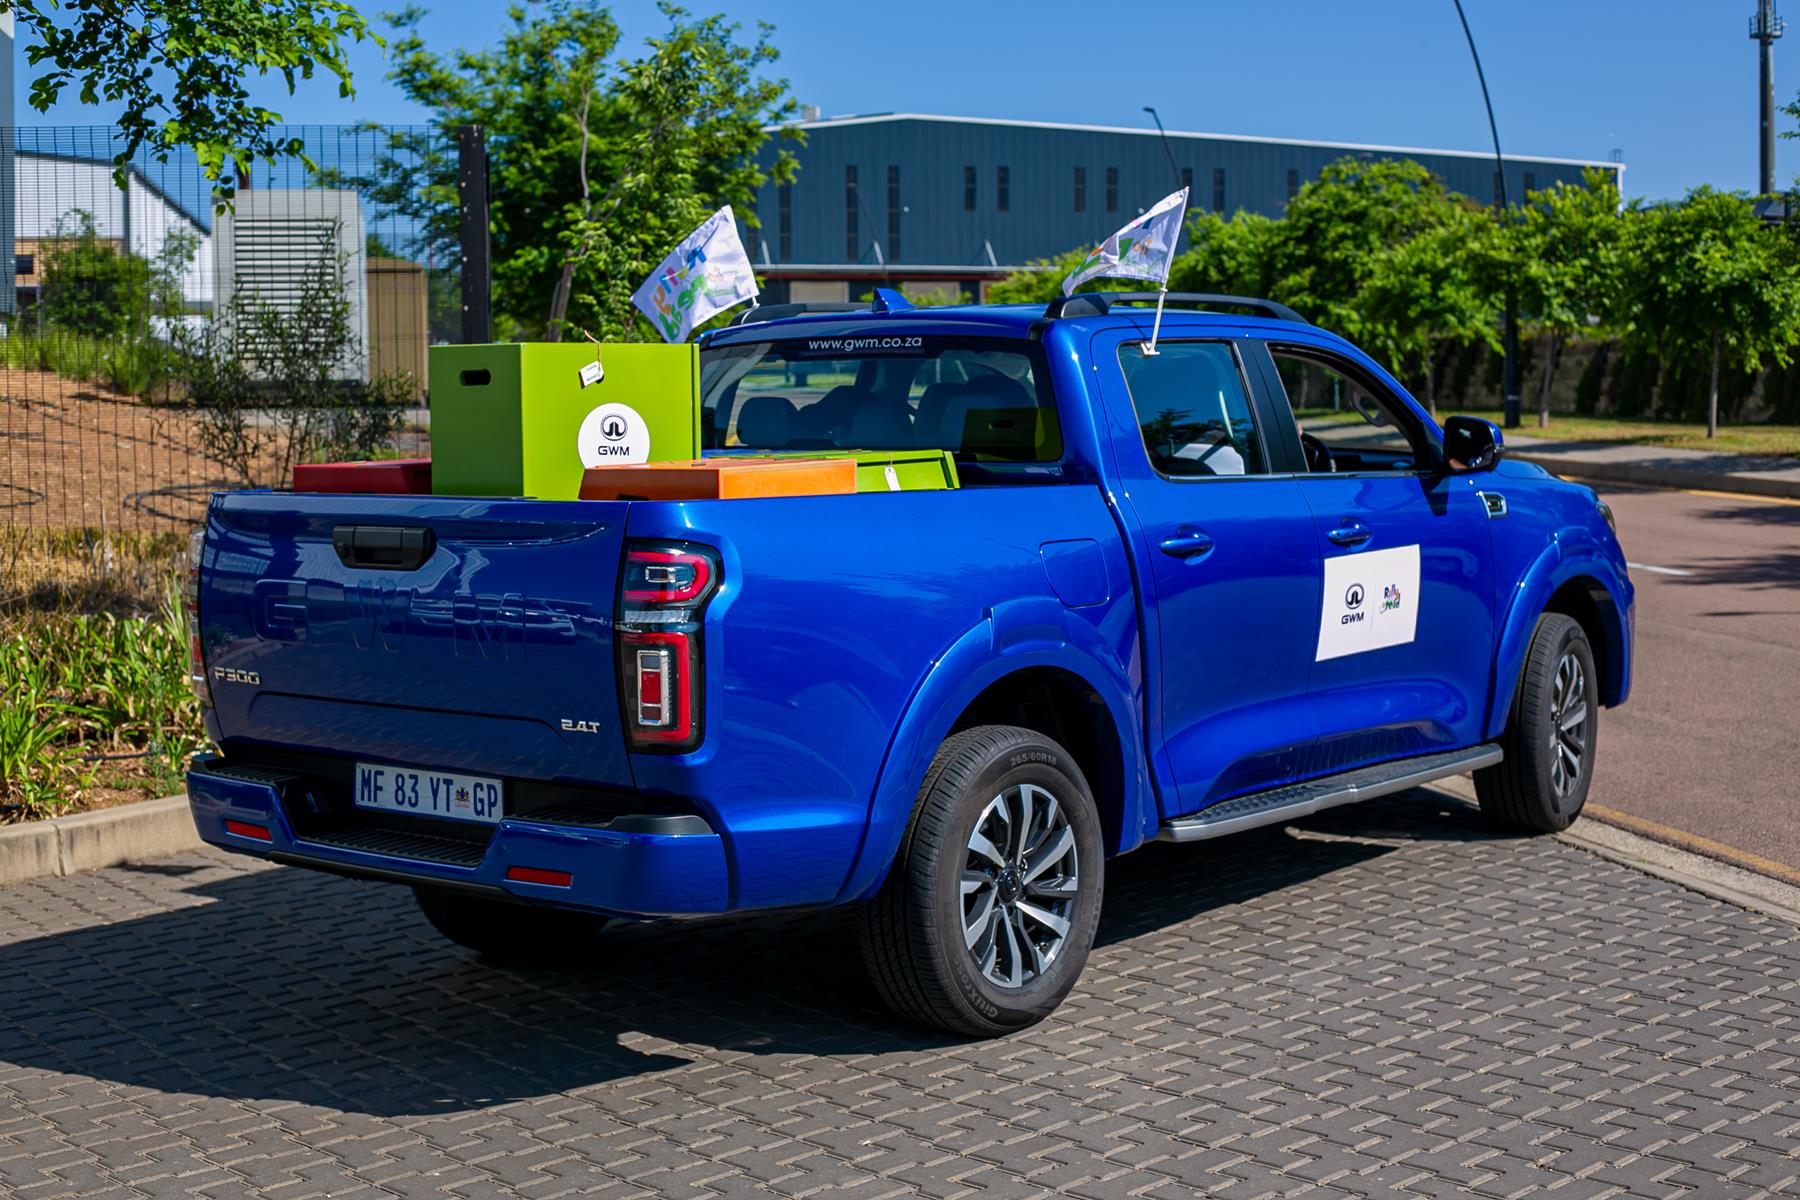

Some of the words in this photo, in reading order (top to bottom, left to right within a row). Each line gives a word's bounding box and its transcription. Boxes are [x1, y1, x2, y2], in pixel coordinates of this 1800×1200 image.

[809, 337, 922, 351] www.gwm.co.za
[598, 445, 630, 456] GWM
[253, 579, 527, 661] GWM
[1341, 612, 1365, 625] GWM
[214, 666, 261, 685] P300
[561, 718, 600, 733] 2.4T
[1010, 751, 1057, 767] 265/60R18
[360, 768, 384, 803] MF
[394, 773, 419, 808] 83
[430, 776, 454, 812] YT
[473, 782, 498, 818] GP
